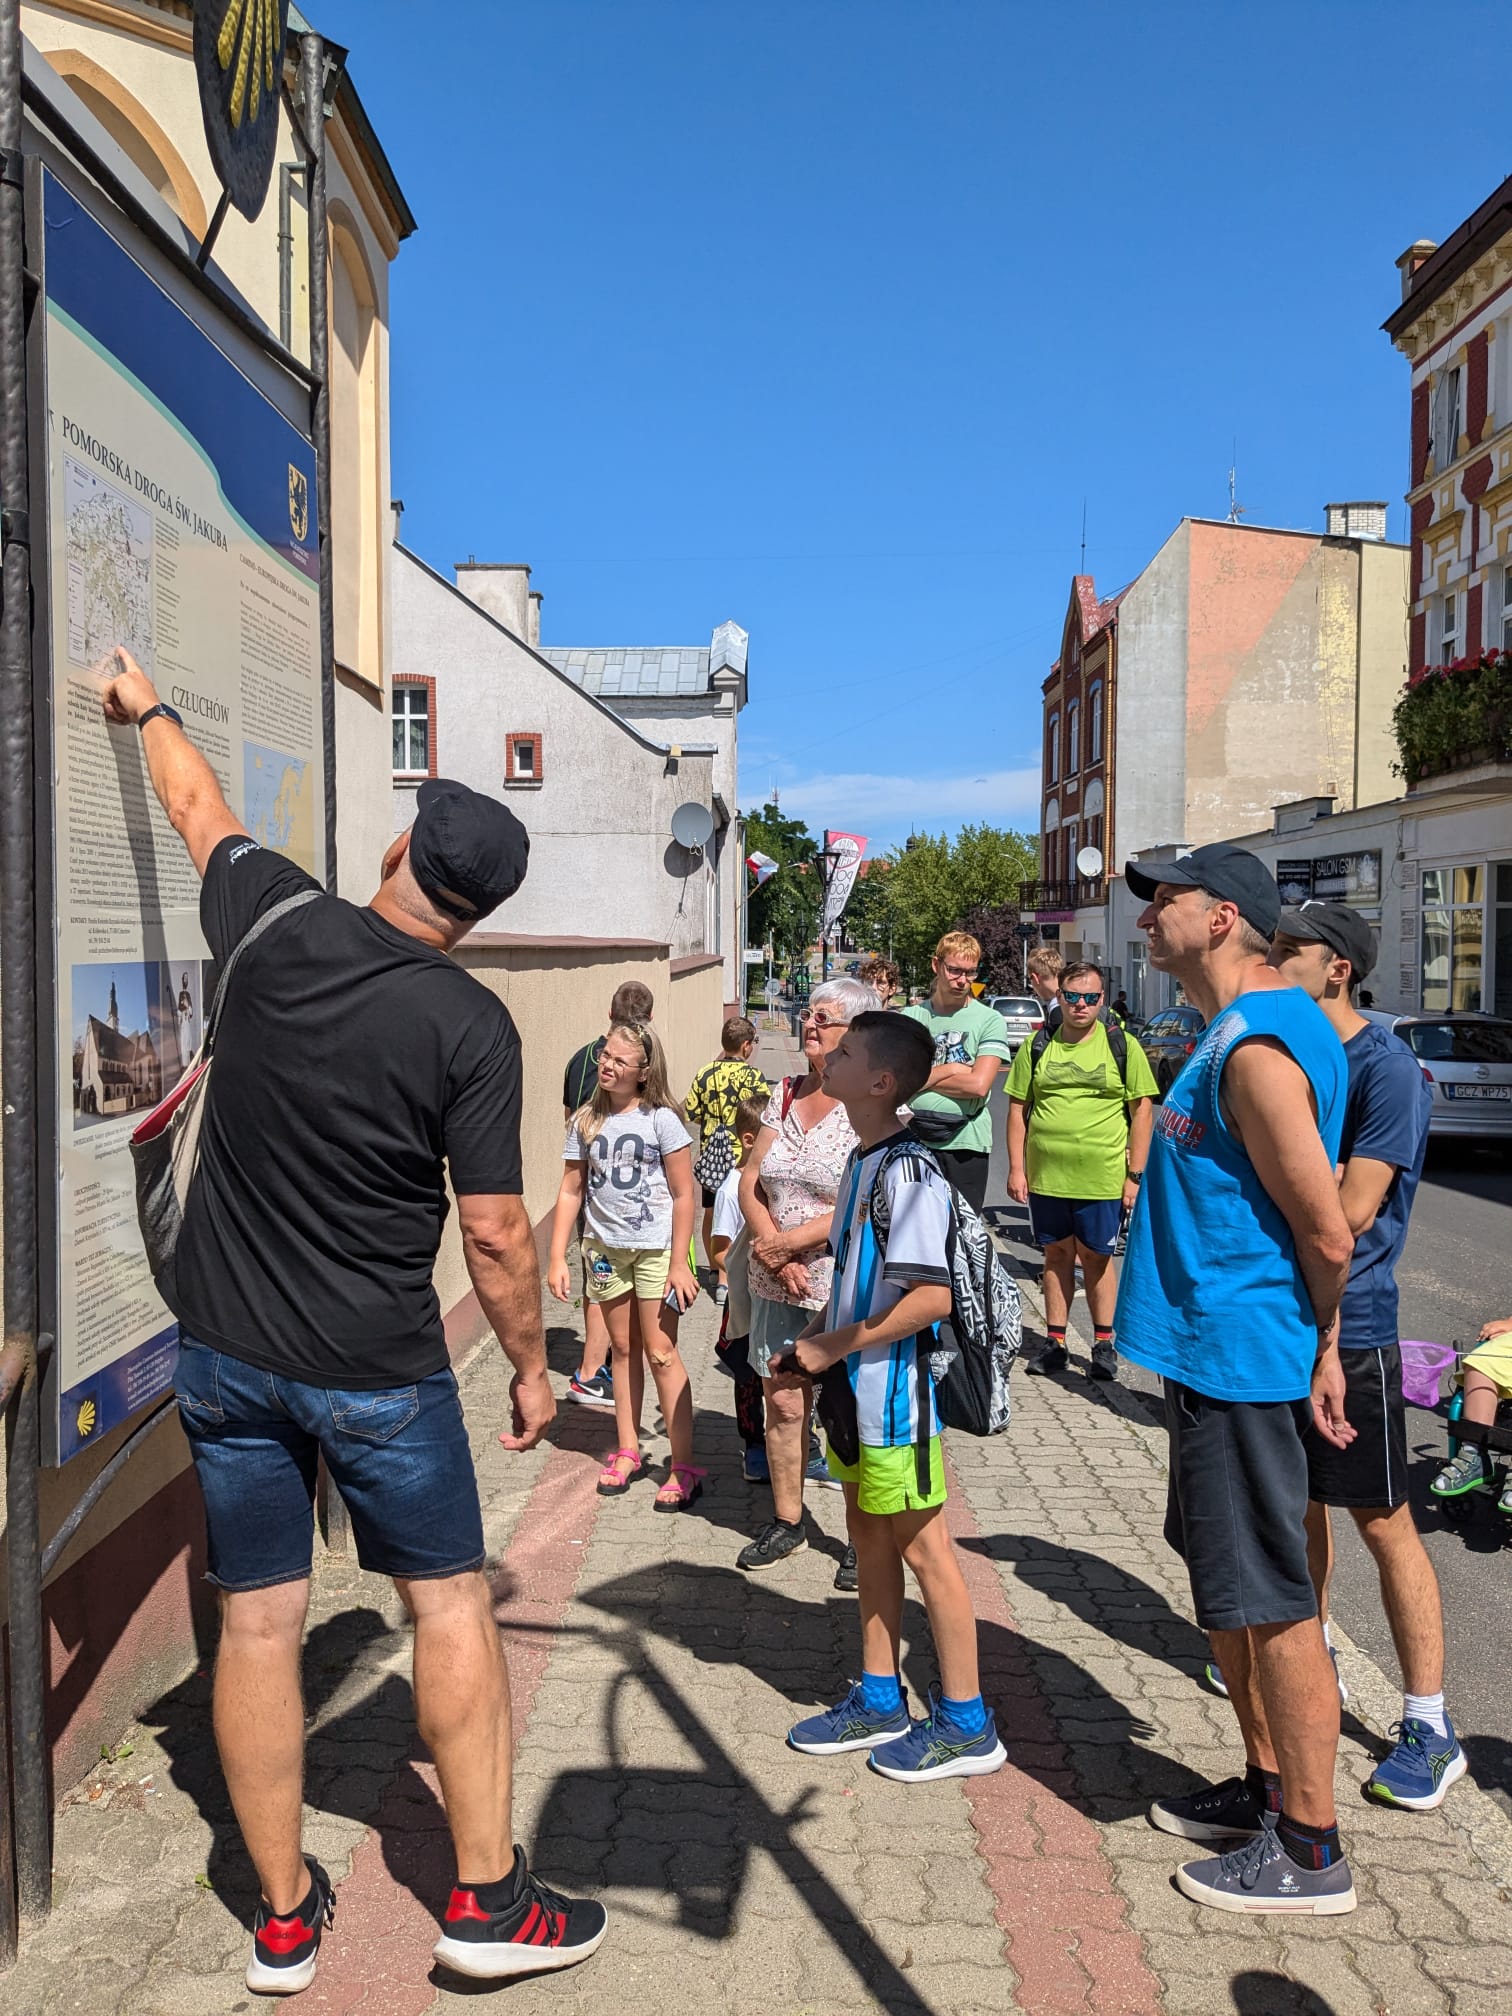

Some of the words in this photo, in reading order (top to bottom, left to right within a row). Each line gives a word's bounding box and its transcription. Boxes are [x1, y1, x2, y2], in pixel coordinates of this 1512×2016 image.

[62, 415, 132, 486] POMORSKA
[134, 469, 173, 515] DROGA
[175, 495, 192, 528] ŚW.
[193, 512, 228, 552] JAKUBA
[171, 685, 229, 725] CZŁUCHÓW
[1316, 859, 1338, 877] SALON
[1339, 856, 1356, 873] GSM
[1457, 1086, 1478, 1097] GCZ
[1481, 1087, 1508, 1098] WP75
